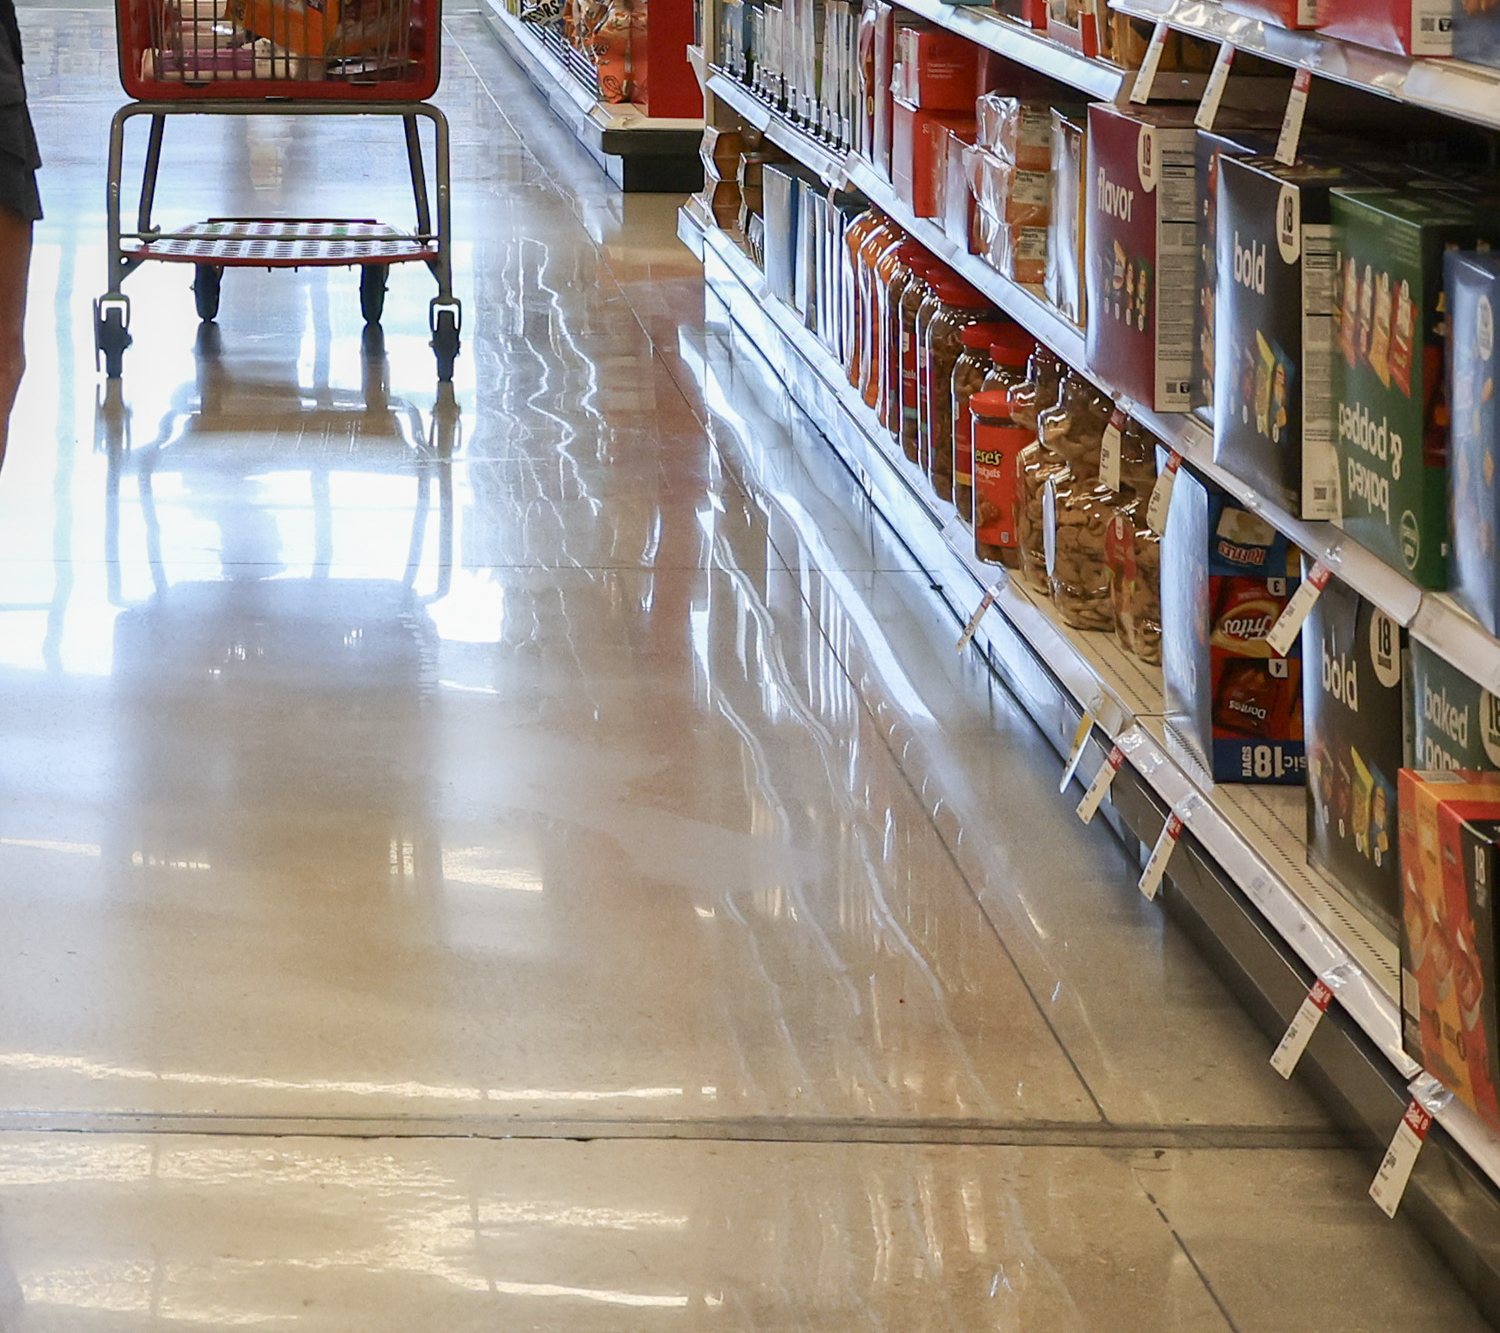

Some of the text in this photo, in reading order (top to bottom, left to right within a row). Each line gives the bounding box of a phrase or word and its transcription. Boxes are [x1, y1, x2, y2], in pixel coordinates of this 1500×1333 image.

[1099, 165, 1134, 223] flavor
[1234, 231, 1266, 295] bold
[1321, 645, 1358, 711] bold
